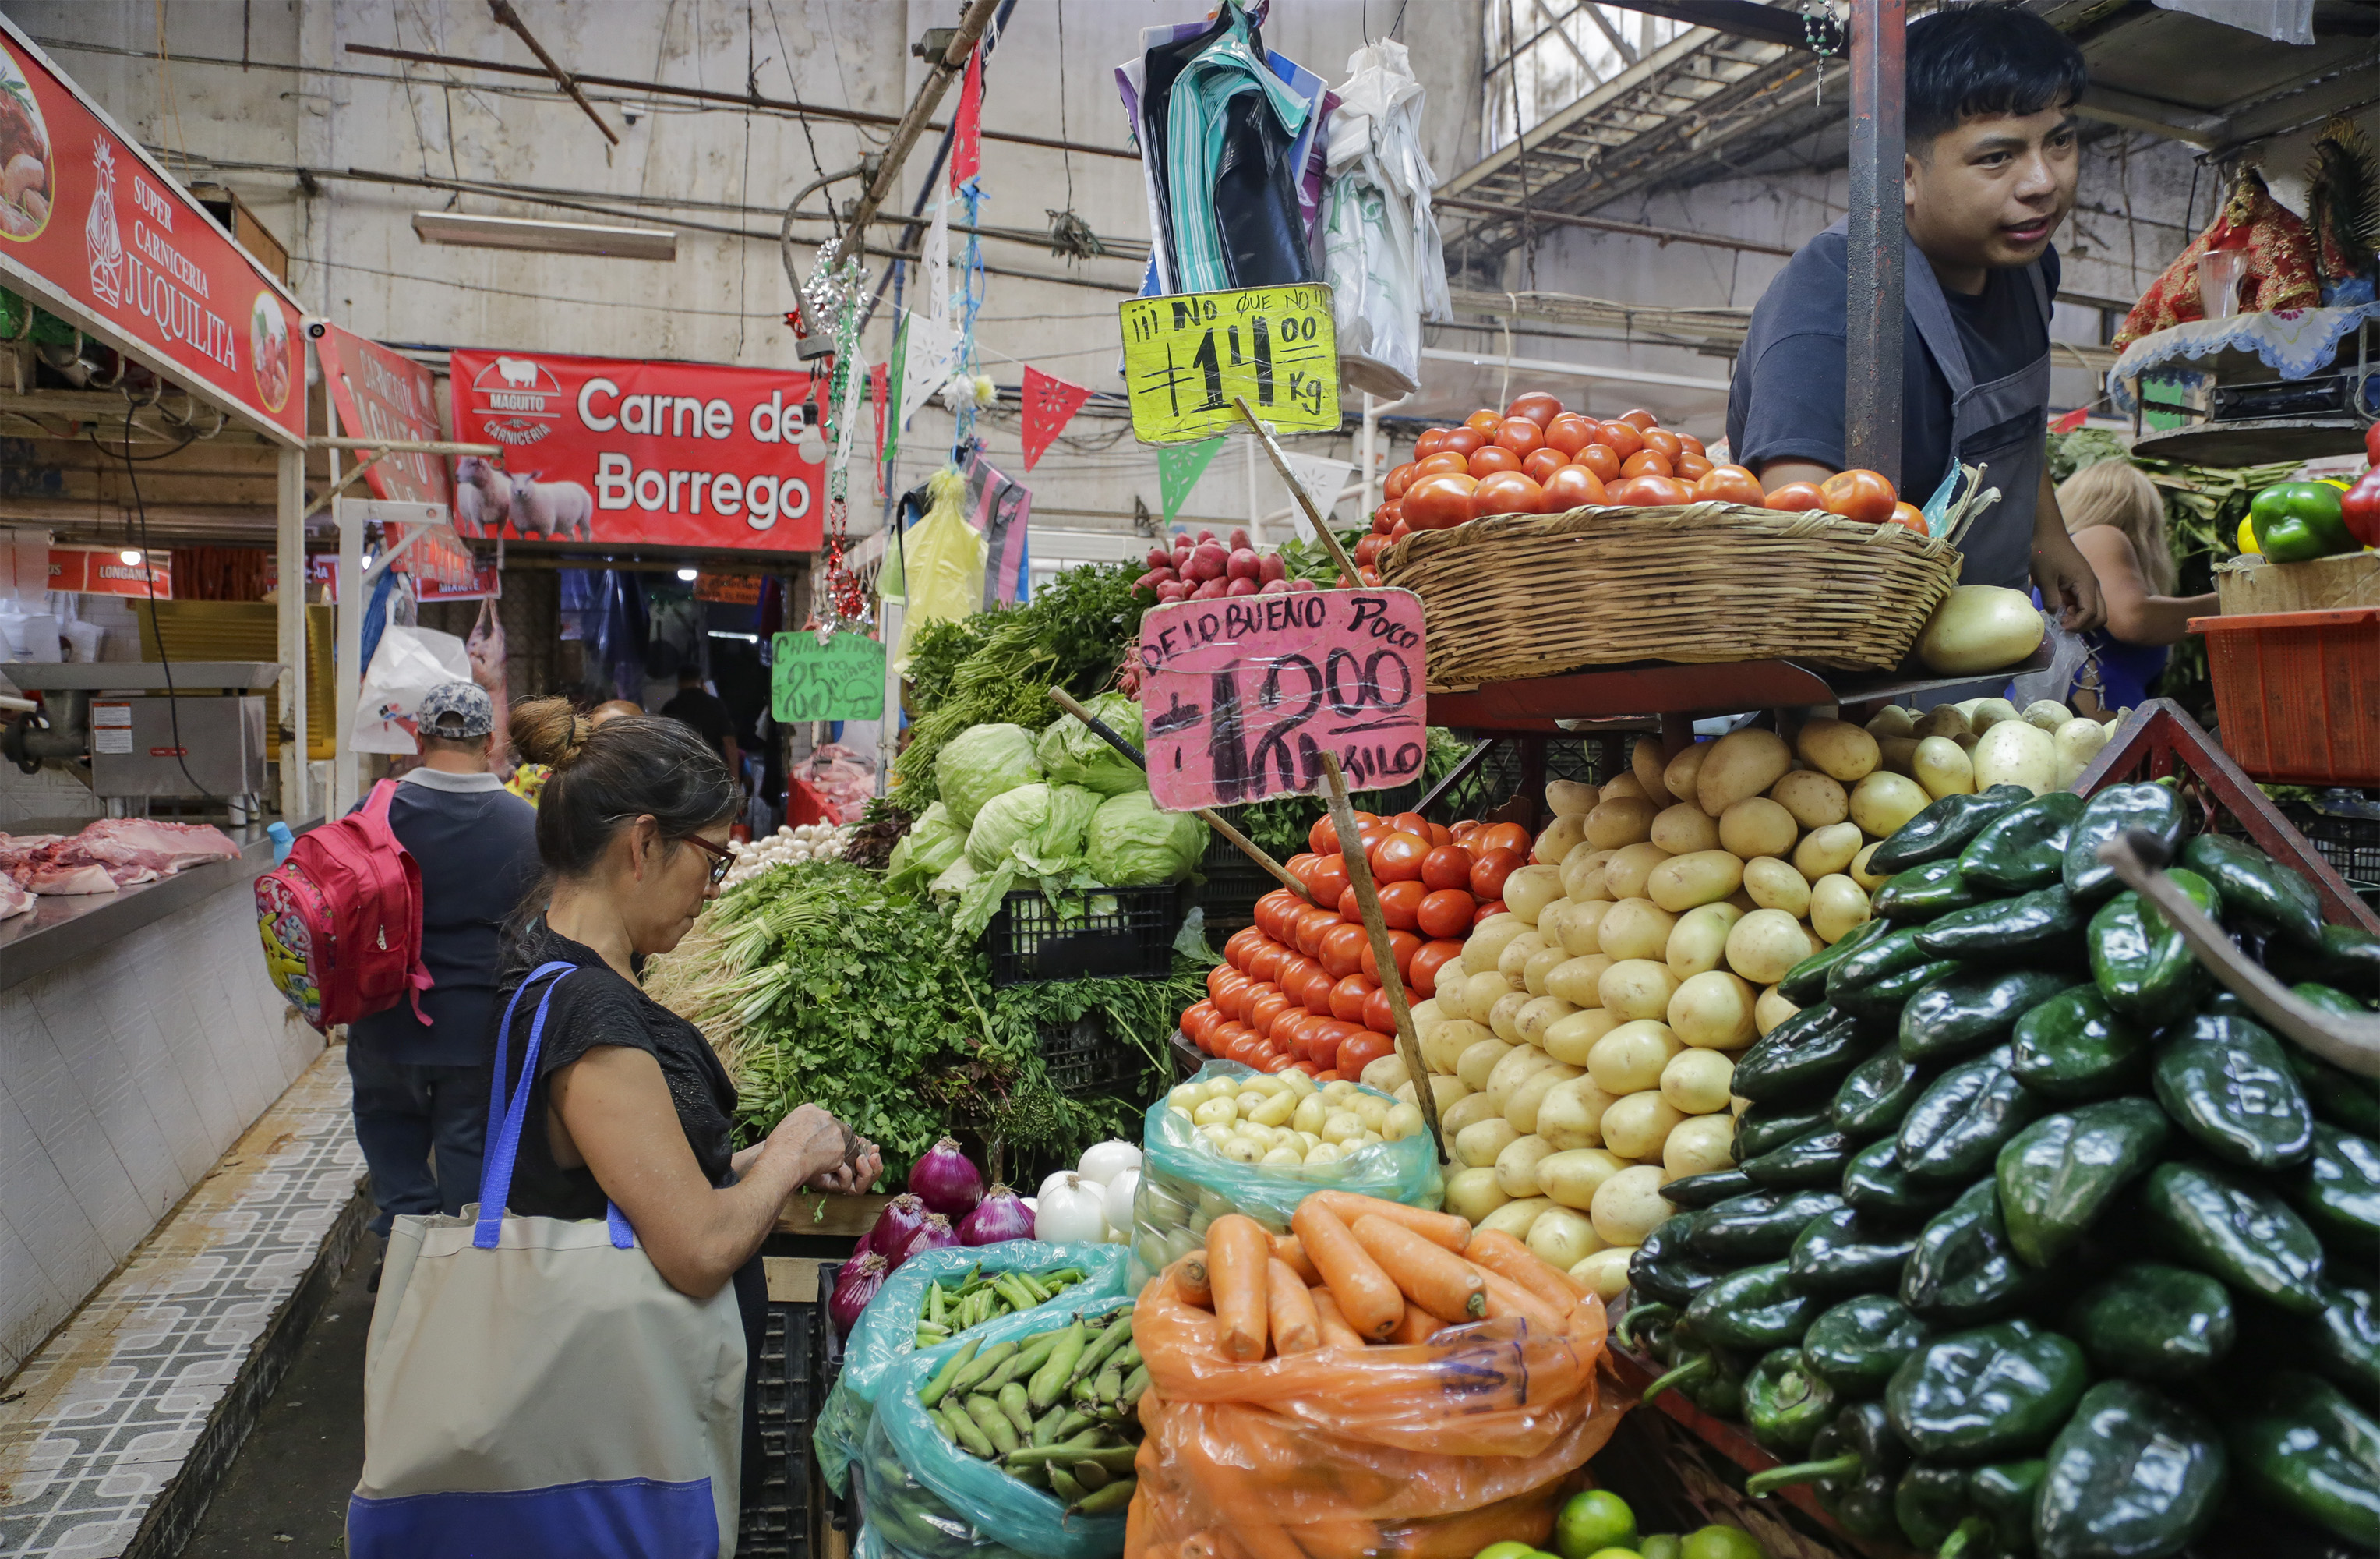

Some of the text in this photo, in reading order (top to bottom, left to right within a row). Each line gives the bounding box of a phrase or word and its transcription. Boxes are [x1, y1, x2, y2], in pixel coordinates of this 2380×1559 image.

[134, 175, 173, 233] SUPER
[135, 220, 209, 299] CARNICERIA
[125, 251, 236, 372] JUQUILITA
[1236, 292, 1273, 319] QUE
[489, 393, 545, 412] MAGUITO
[577, 377, 807, 444] Carne de
[483, 420, 552, 446] CARNICERIA
[594, 451, 810, 530] Borrego
[1225, 596, 1326, 640] BUENO
[1338, 741, 1424, 787] KILO
